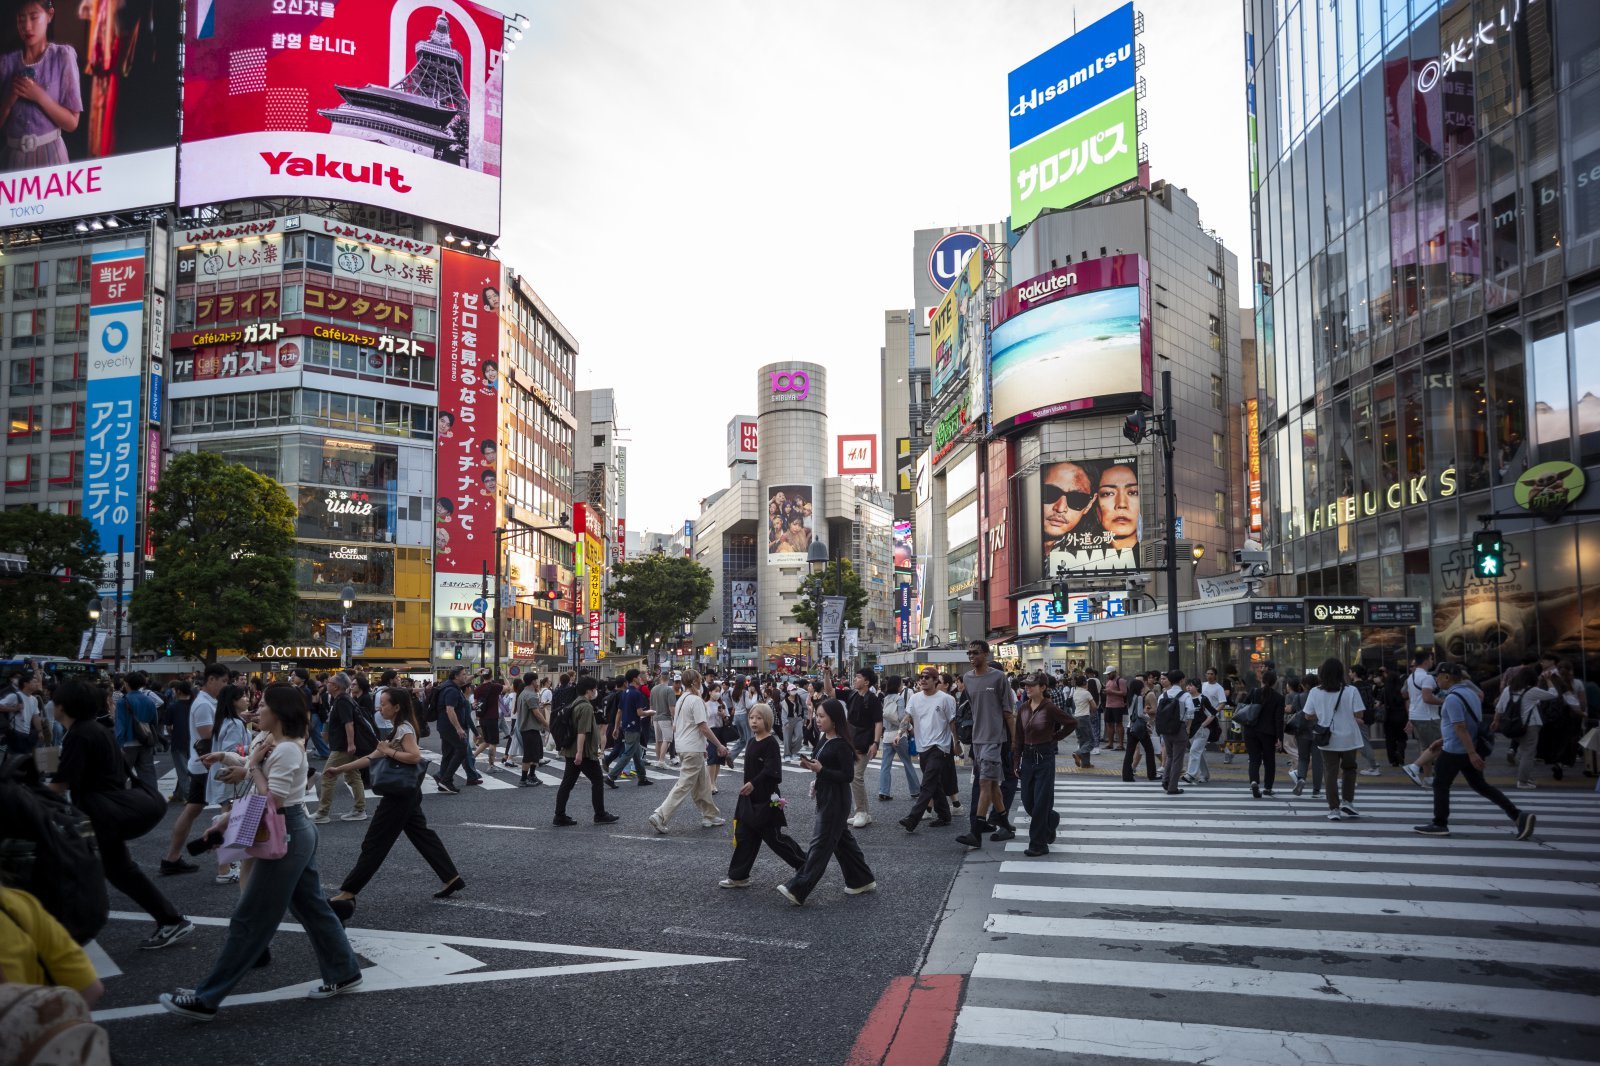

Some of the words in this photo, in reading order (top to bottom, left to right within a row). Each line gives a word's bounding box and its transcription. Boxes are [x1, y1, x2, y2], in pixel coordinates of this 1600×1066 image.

[272, 33, 302, 49] 환영
[309, 35, 356, 55] 합니다
[1010, 43, 1131, 117] Hisamitsu
[260, 151, 412, 194] Yakult
[1017, 122, 1128, 201] サロンパス
[10, 204, 45, 218] TOKYO
[186, 219, 277, 243] しゃぶしゃぶバイキング
[324, 220, 434, 256] しゃぶしゃぶバイキング
[180, 259, 195, 272] 9F
[227, 243, 277, 268] しゃぶ葉
[99, 265, 136, 282] 当ビル
[370, 254, 433, 284] しゃぶ葉
[108, 283, 127, 298] 5F
[1018, 272, 1077, 303] Rakuten
[198, 290, 278, 318] プライス
[305, 289, 409, 324] コンタクト
[243, 321, 285, 343] ガスト
[378, 334, 425, 357] ガスト
[93, 354, 135, 372] eyecity
[175, 359, 194, 374] 7F
[221, 350, 272, 377] ガスト
[769, 370, 810, 401] 109
[1033, 407, 1052, 419] Rakuten
[1051, 404, 1068, 414] Vision
[88, 401, 114, 526] アイシティ
[112, 399, 133, 525] コンタクトの
[848, 447, 867, 461] H&M
[1066, 530, 1117, 548] 外道の歌
[449, 602, 474, 611] 17LIV
[1328, 605, 1360, 616] しぶちか
